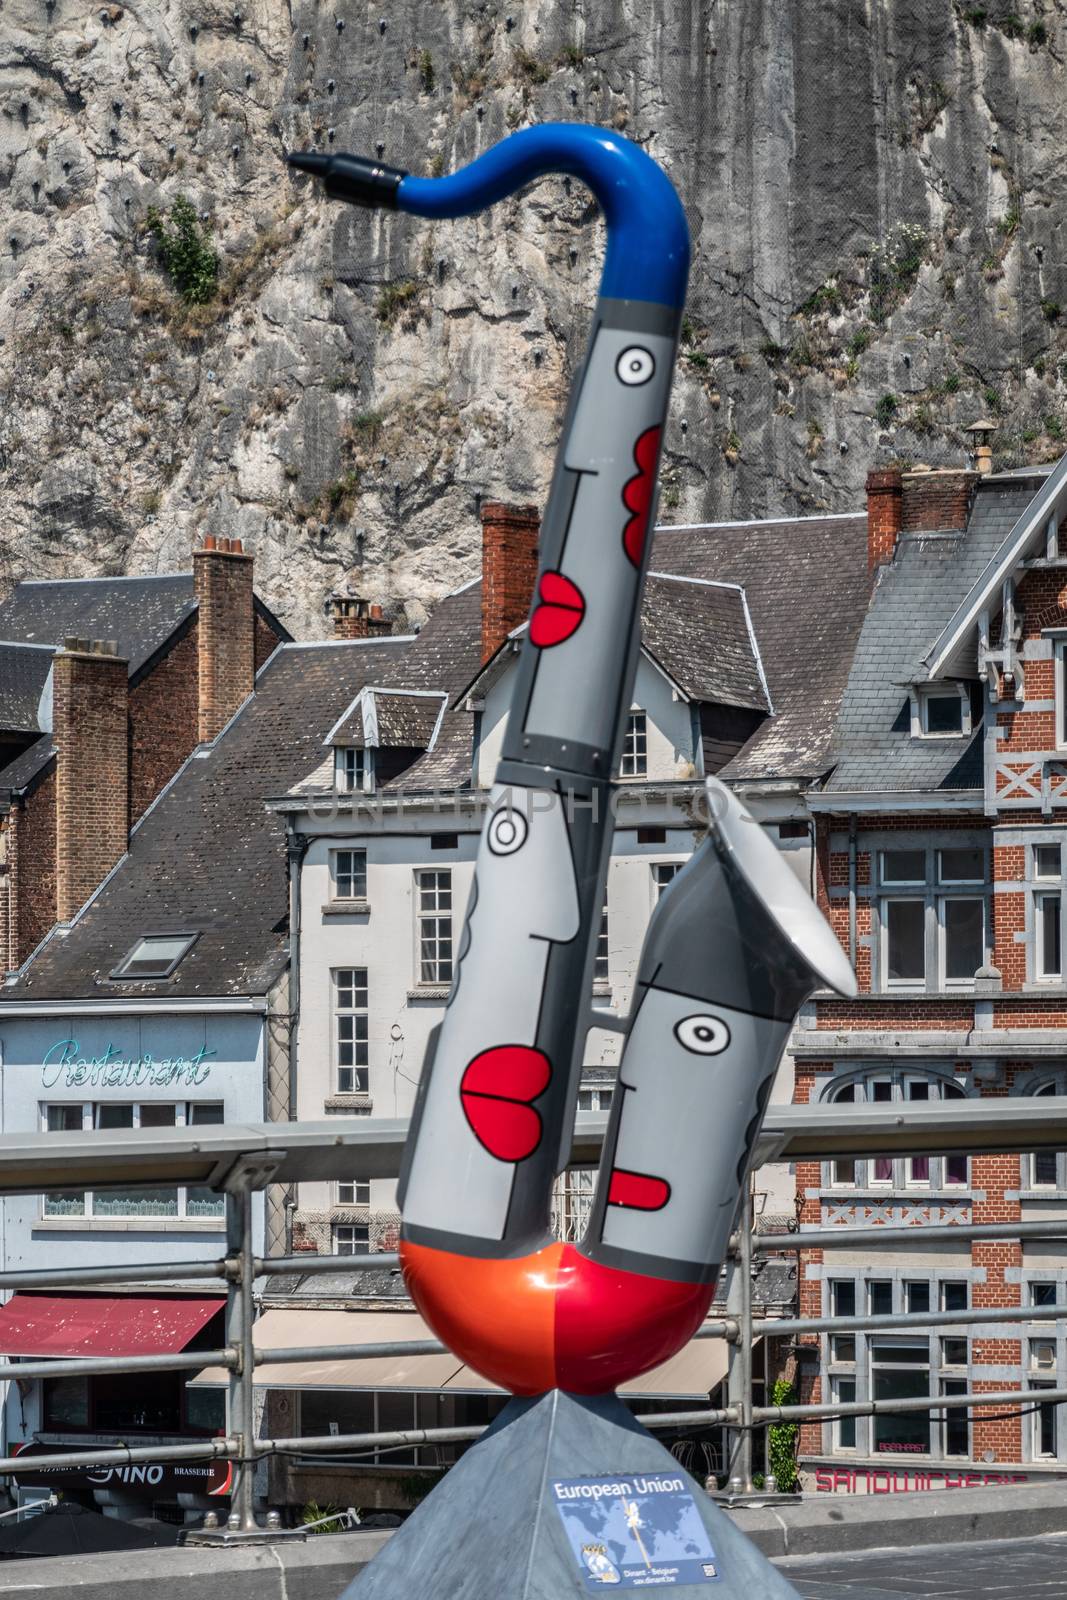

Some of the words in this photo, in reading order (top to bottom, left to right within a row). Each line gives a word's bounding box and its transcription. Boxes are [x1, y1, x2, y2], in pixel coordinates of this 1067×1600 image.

[42, 1039, 217, 1088] Restaurant
[174, 1467, 215, 1477] BRASSERIE
[554, 1483, 632, 1500] European
[635, 1477, 685, 1494] Union
